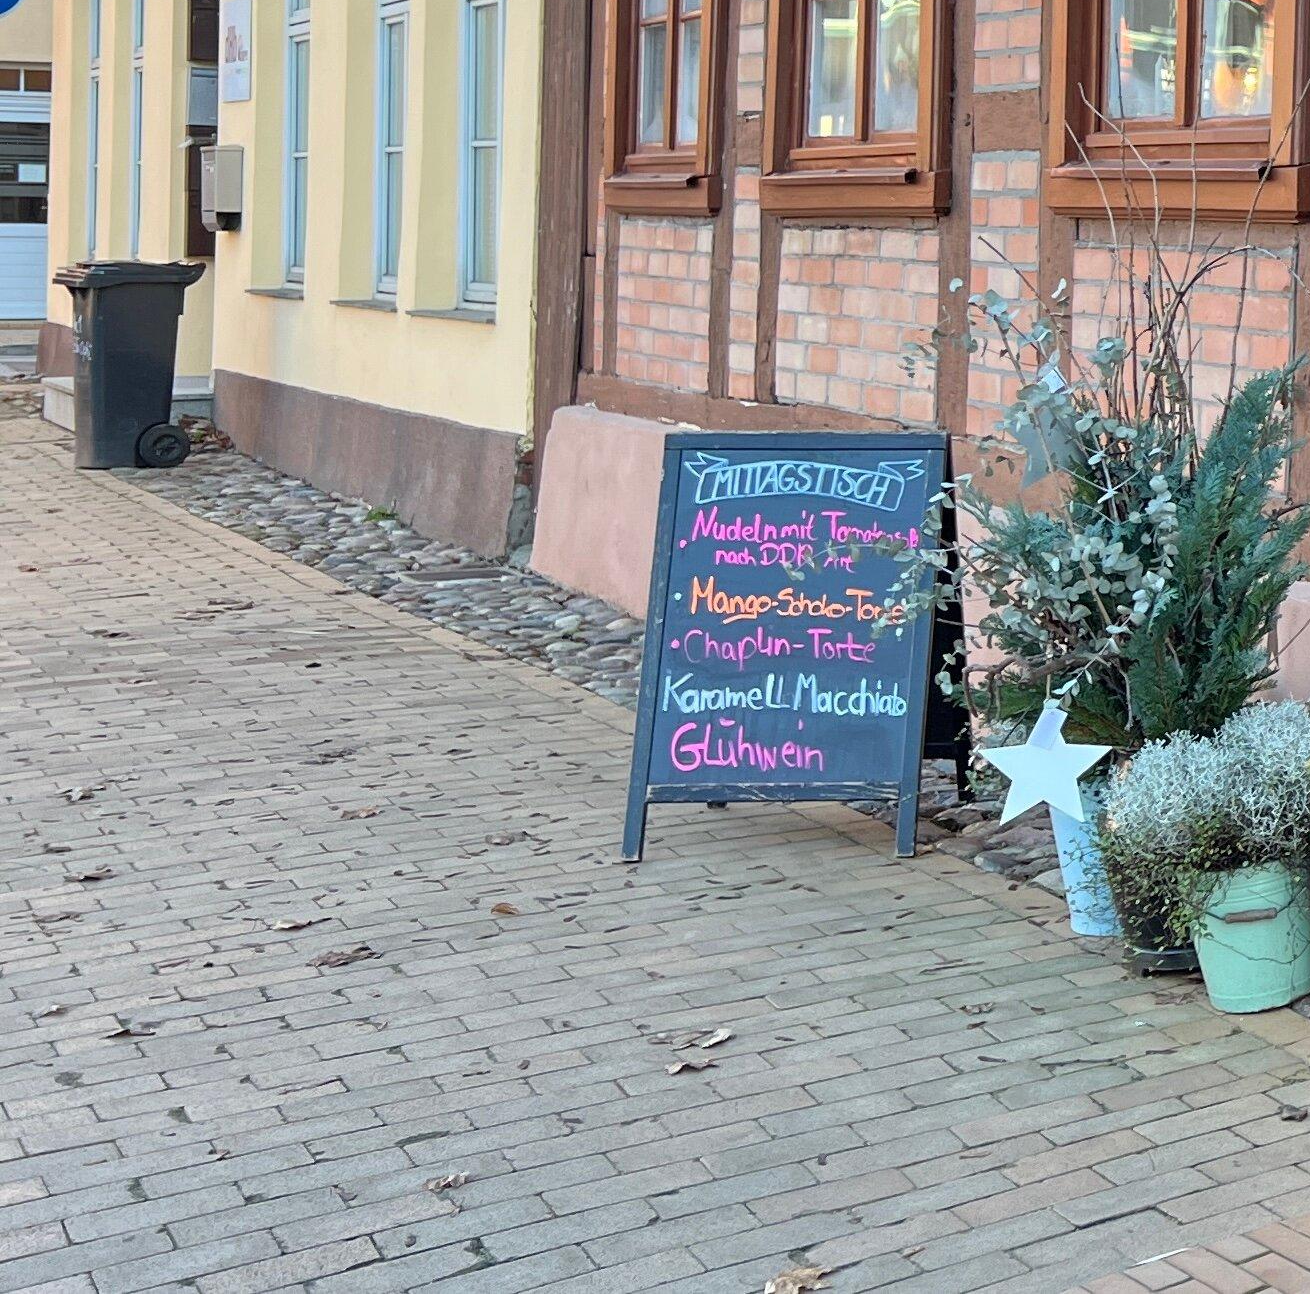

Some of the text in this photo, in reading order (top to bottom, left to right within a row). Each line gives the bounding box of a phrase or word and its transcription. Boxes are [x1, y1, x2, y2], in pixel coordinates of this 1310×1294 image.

[712, 462, 893, 505] MITTAGSTISCH
[691, 505, 777, 544] Nudeln
[780, 509, 819, 542] mit
[715, 546, 757, 566] nach
[759, 542, 814, 568] DDR
[689, 575, 906, 625] Mango-Schoko-Tore
[683, 626, 877, 672] Chaplin-Torte
[661, 672, 908, 717] Karamell Macchiato
[670, 716, 825, 773] Glühwein
